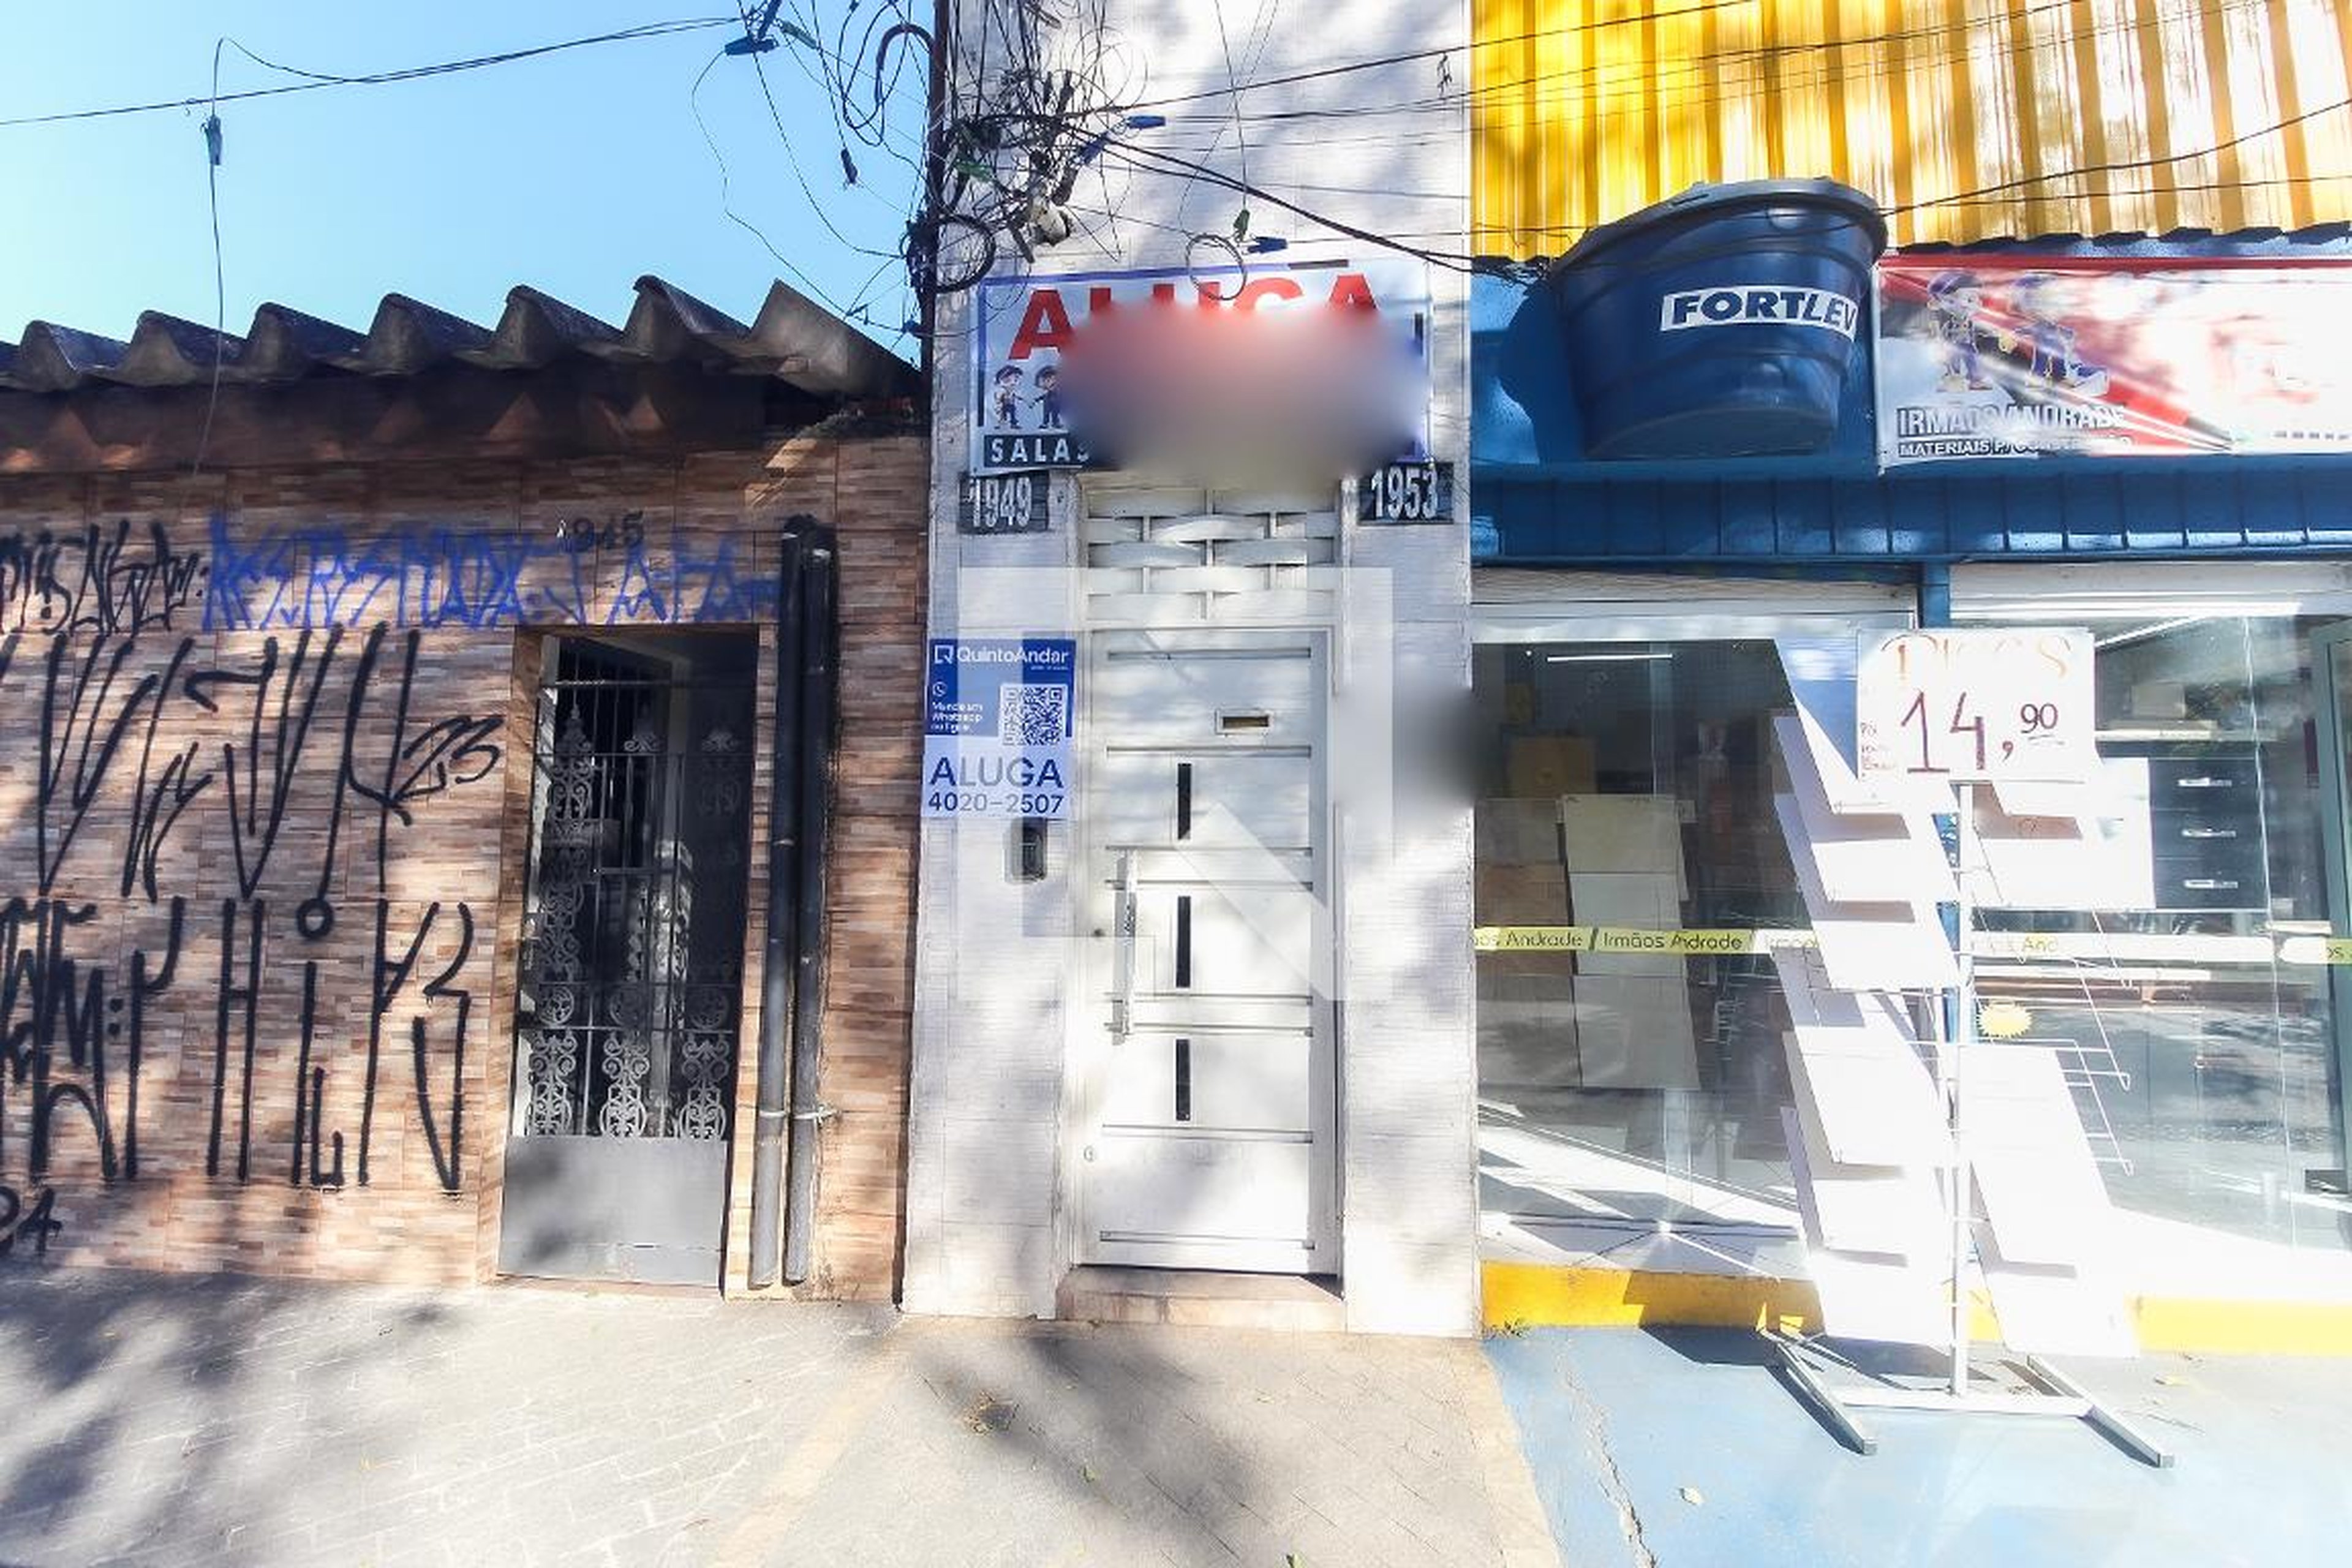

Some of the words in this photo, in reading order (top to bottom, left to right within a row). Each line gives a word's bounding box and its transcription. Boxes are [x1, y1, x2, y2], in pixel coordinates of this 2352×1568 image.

[1672, 290, 1857, 331] FORTLEV
[1899, 440, 1991, 456] MATERIAIS
[965, 476, 1032, 527] 1949
[1371, 466, 1438, 519] 1953
[956, 646, 1069, 665] QuintoAndar
[929, 756, 1065, 789] ALUGA
[928, 791, 1065, 814] 4020-2507
[1506, 930, 1583, 947] Andrade
[1604, 932, 1664, 948] Irmãos
